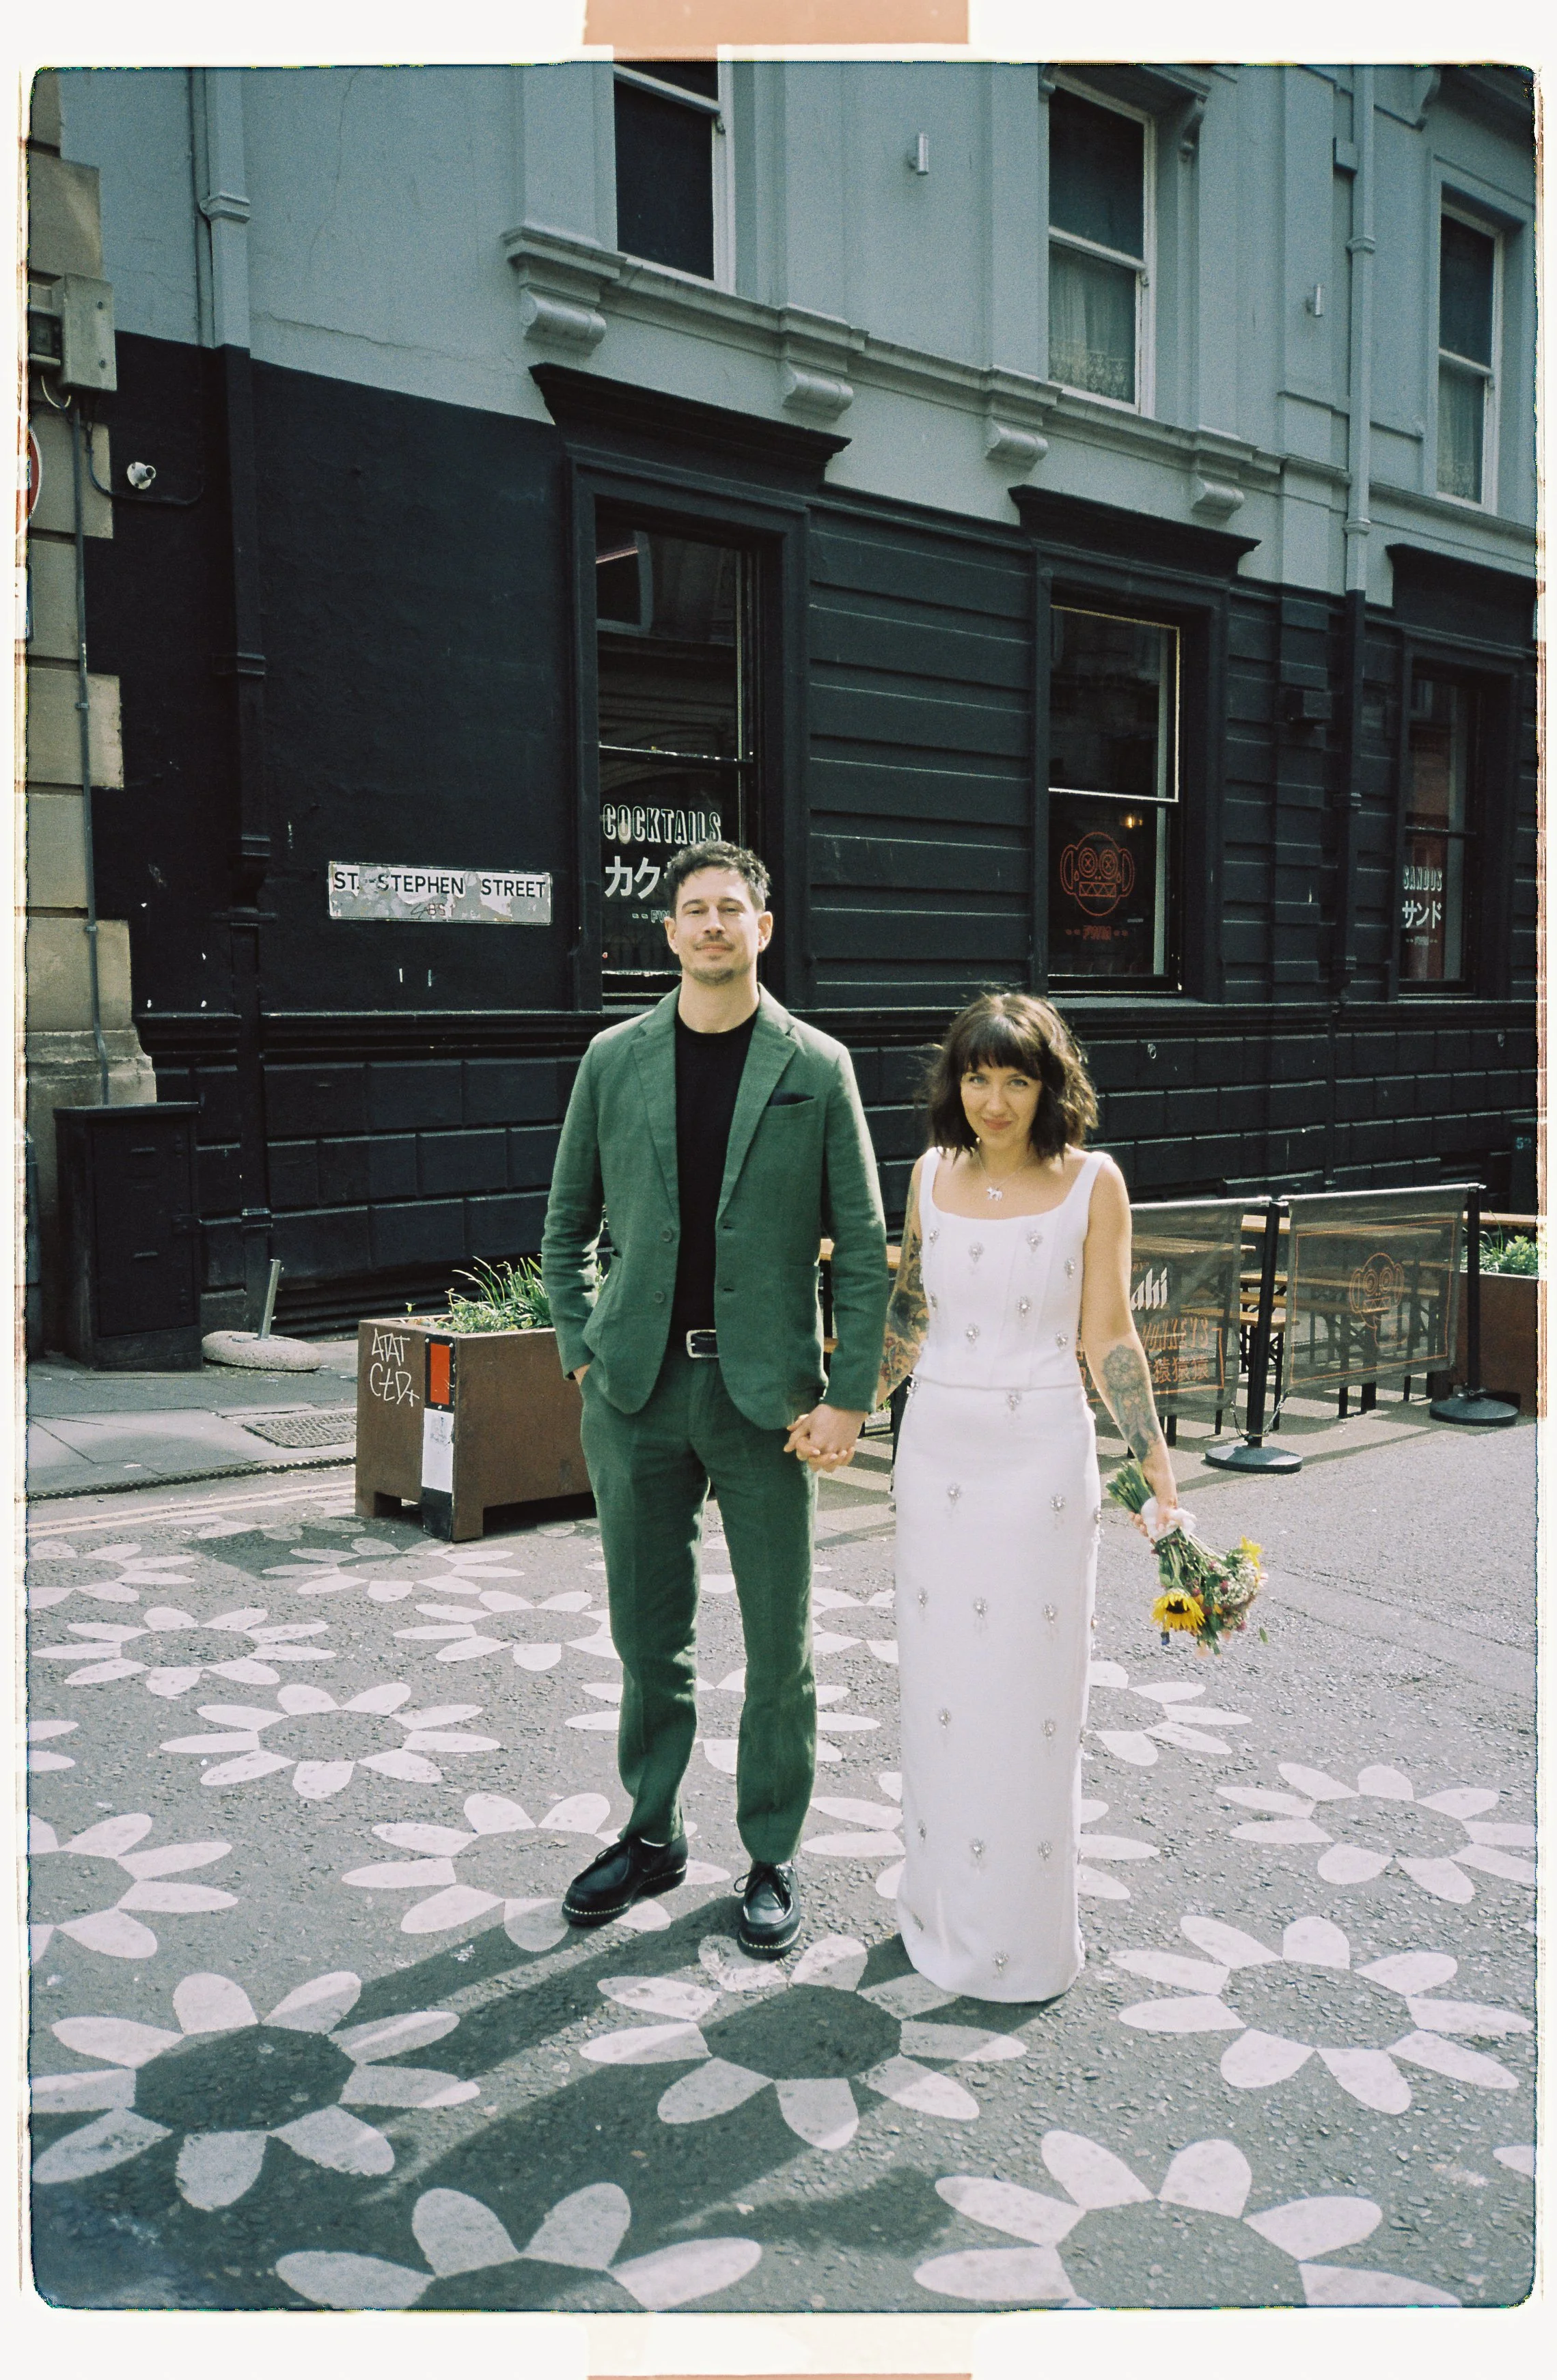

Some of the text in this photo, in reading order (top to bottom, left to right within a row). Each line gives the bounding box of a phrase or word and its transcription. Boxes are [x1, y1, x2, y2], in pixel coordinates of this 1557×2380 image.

[603, 803, 721, 844] COCKTAILS
[334, 871, 546, 898] ST. STEPHEN STREET
[1402, 900, 1442, 929] サンド
